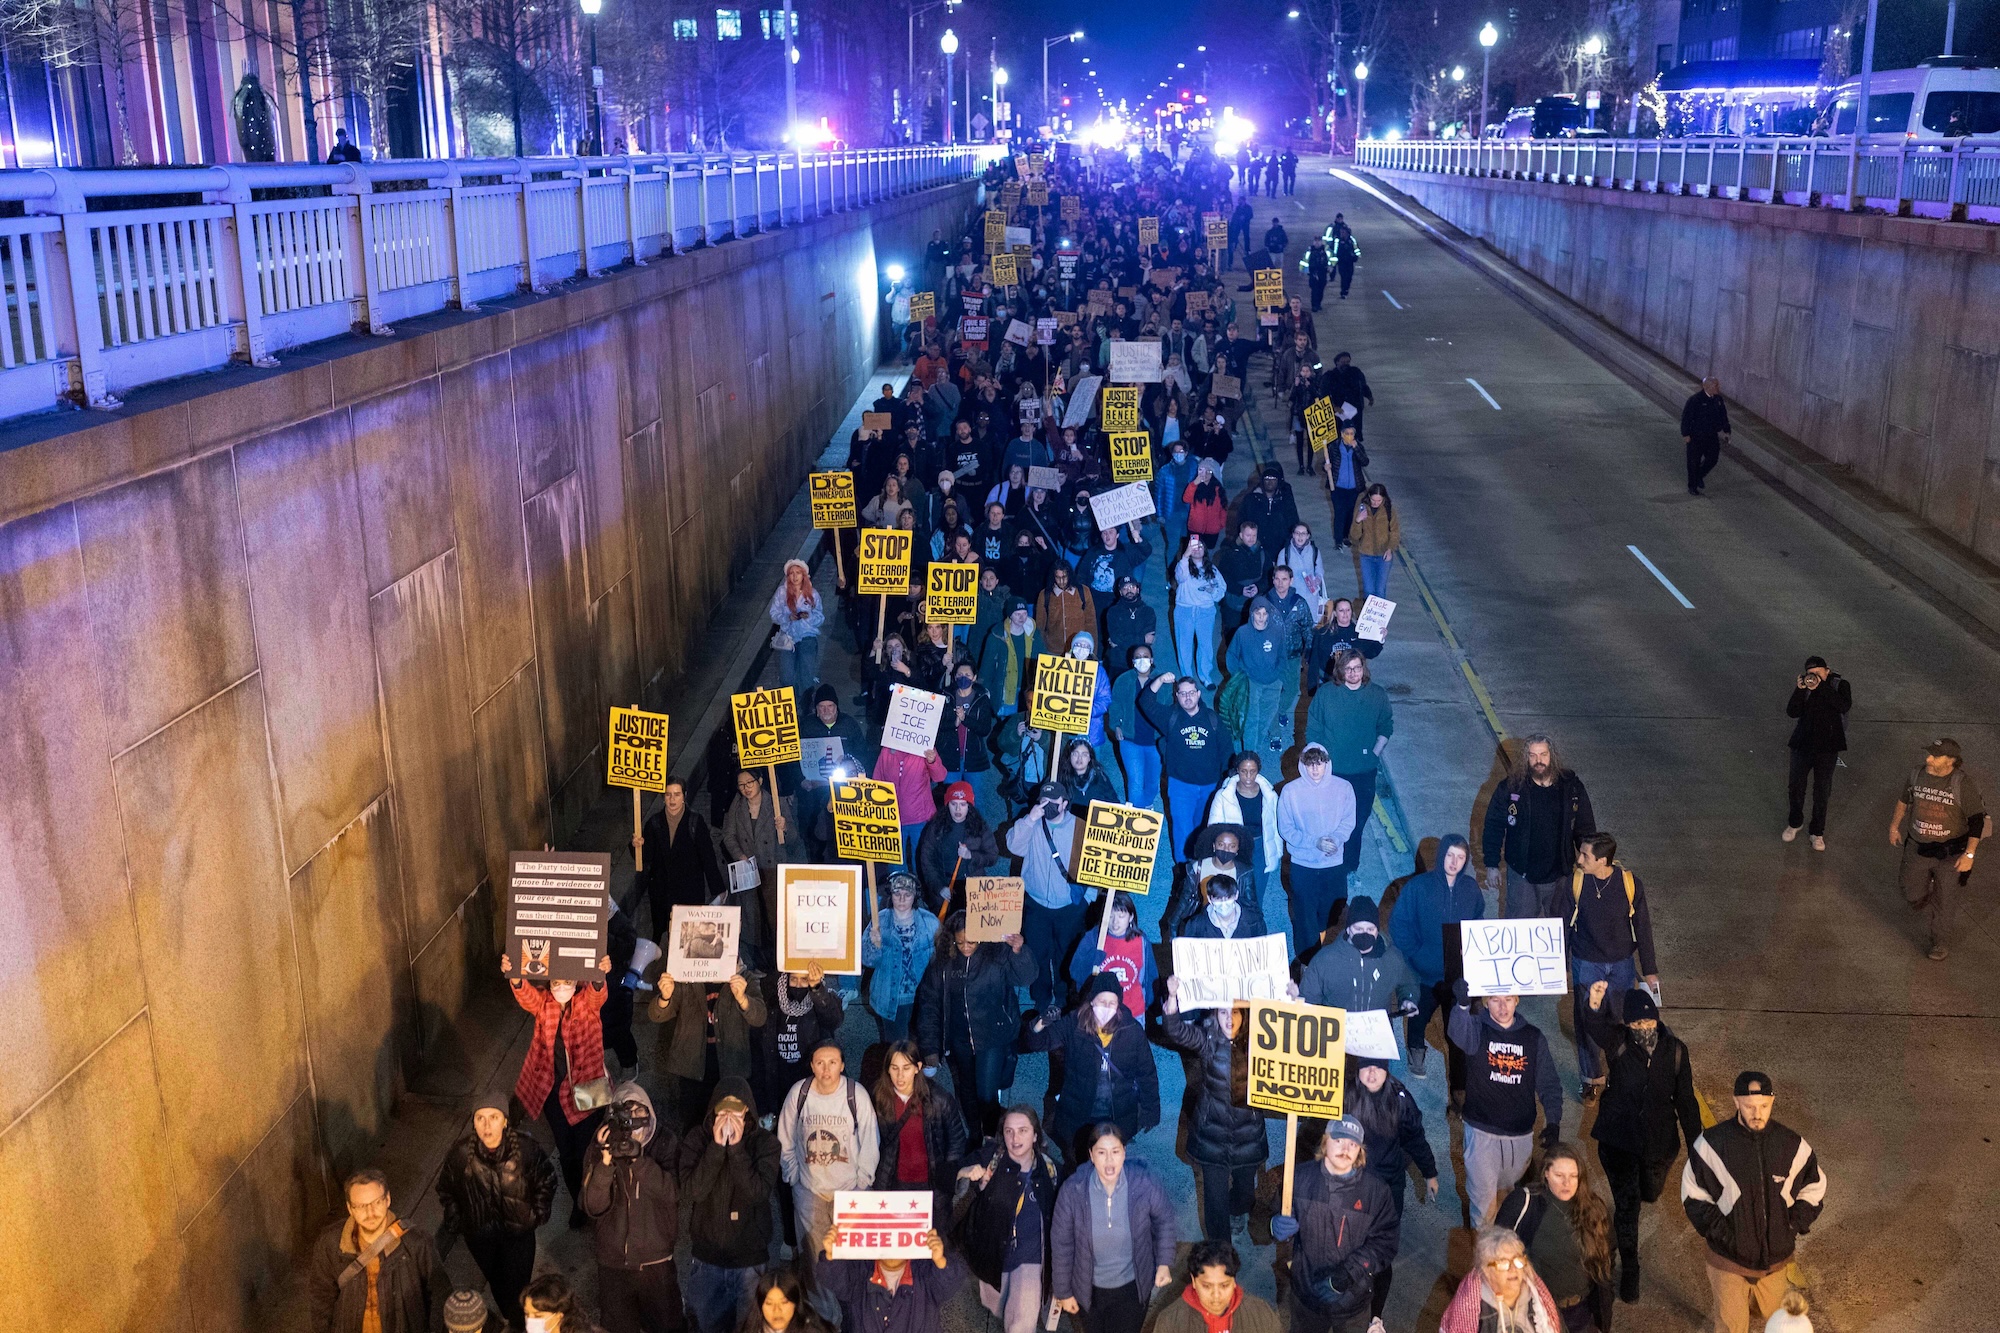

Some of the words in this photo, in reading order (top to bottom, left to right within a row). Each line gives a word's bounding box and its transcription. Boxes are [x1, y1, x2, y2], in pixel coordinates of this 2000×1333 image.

[1256, 271, 1281, 280] DC
[911, 294, 933, 303] DC
[962, 296, 983, 304] TRUMP
[1190, 301, 1208, 309] ICE
[1115, 344, 1153, 358] JUSTICE
[1106, 390, 1136, 401] JUSTICE
[1105, 401, 1135, 409] FOR
[1306, 400, 1330, 417] JAIL
[1105, 409, 1135, 420] RENEE
[1307, 406, 1333, 430] KILLER
[1312, 418, 1335, 440] ICE
[1313, 429, 1336, 445] AGENTS
[1113, 436, 1147, 457] STOP
[1114, 459, 1124, 469] ICE
[1125, 458, 1150, 469] TERROR
[1116, 468, 1149, 476] NOW
[811, 475, 852, 490] DC
[812, 490, 853, 500] MINNEAPOLIS
[1101, 490, 1124, 506] FROM
[1125, 485, 1138, 498] DC
[813, 502, 854, 510] STOP
[1097, 506, 1110, 517] TO
[1112, 492, 1152, 513] PALESTINE
[1136, 503, 1152, 516] CRIME
[814, 511, 826, 521] ICE
[826, 510, 855, 521] TERROR
[864, 534, 909, 560] STOP
[985, 551, 1000, 559] NO
[861, 564, 874, 575] ICE
[876, 564, 908, 576] TERROR
[863, 577, 905, 585] NOW
[931, 568, 976, 592] STOP
[928, 596, 942, 606] ICE
[943, 596, 975, 607] TERROR
[1359, 622, 1372, 633] Evil
[1040, 657, 1094, 675] JAIL
[1037, 670, 1093, 697] KILLER
[735, 689, 792, 708] JAIL
[899, 696, 935, 714] STOP
[1036, 692, 1090, 716] ICE
[736, 703, 795, 730] KILLER
[900, 713, 927, 730] ICE
[1035, 711, 1087, 724] AGENTS
[615, 713, 666, 738] JUSTICE
[614, 732, 663, 752] FOR
[741, 725, 797, 749] ICE
[890, 726, 930, 747] TERROR
[743, 744, 798, 757] AGENTS
[613, 747, 661, 771] RENEE
[802, 761, 818, 769] EVER
[611, 765, 662, 781] GOOD
[832, 781, 895, 806] DC
[1922, 787, 1939, 795] GAVE
[1926, 794, 1942, 803] GAVE
[1942, 798, 1954, 806] ALL
[835, 803, 897, 821] MINNEAPOLIS
[1110, 807, 1141, 817] FROM
[837, 820, 899, 835] STOP
[1090, 806, 1159, 836] DC
[1086, 828, 1155, 850] MINNEAPOLIS
[1928, 829, 1951, 837] TRUMP
[838, 832, 856, 848] ICE
[857, 834, 900, 852] TERROR
[1084, 845, 1153, 864] STOP
[517, 863, 536, 871] "The
[538, 864, 558, 872] Party
[1082, 857, 1102, 874] ICE
[1104, 861, 1150, 882] TERROR
[513, 878, 540, 887] ignore
[556, 880, 592, 888] evidence
[594, 881, 602, 889] of
[978, 879, 995, 892] NO
[517, 894, 536, 902] your
[536, 895, 556, 903] eyes
[595, 898, 601, 906] It
[797, 895, 837, 908] FUCK
[969, 892, 981, 901] For
[984, 890, 1019, 900] Murders
[970, 901, 999, 913] Abolish
[999, 900, 1022, 911] ICE
[535, 911, 553, 919] their
[555, 912, 575, 921] final,
[688, 910, 723, 919] WANTED
[516, 927, 551, 935] essential
[552, 929, 599, 938] command."
[805, 921, 830, 934] ICE
[529, 939, 544, 949] 1984
[1463, 925, 1562, 957] ABOLISH
[693, 960, 710, 968] FOR
[683, 971, 719, 979] MURDER
[787, 1024, 797, 1033] THE
[1257, 1008, 1340, 1059] STOP
[1488, 1041, 1523, 1057] QUESTION
[1252, 1056, 1275, 1079] ICE
[1279, 1062, 1340, 1088] TERROR
[1490, 1071, 1522, 1084] AUTHORITY
[1256, 1080, 1335, 1102] NOW
[802, 1115, 848, 1125] WASHINGTON
[1342, 1120, 1360, 1133] YETI
[835, 1232, 892, 1247] FREE
[898, 1231, 928, 1247] DC
